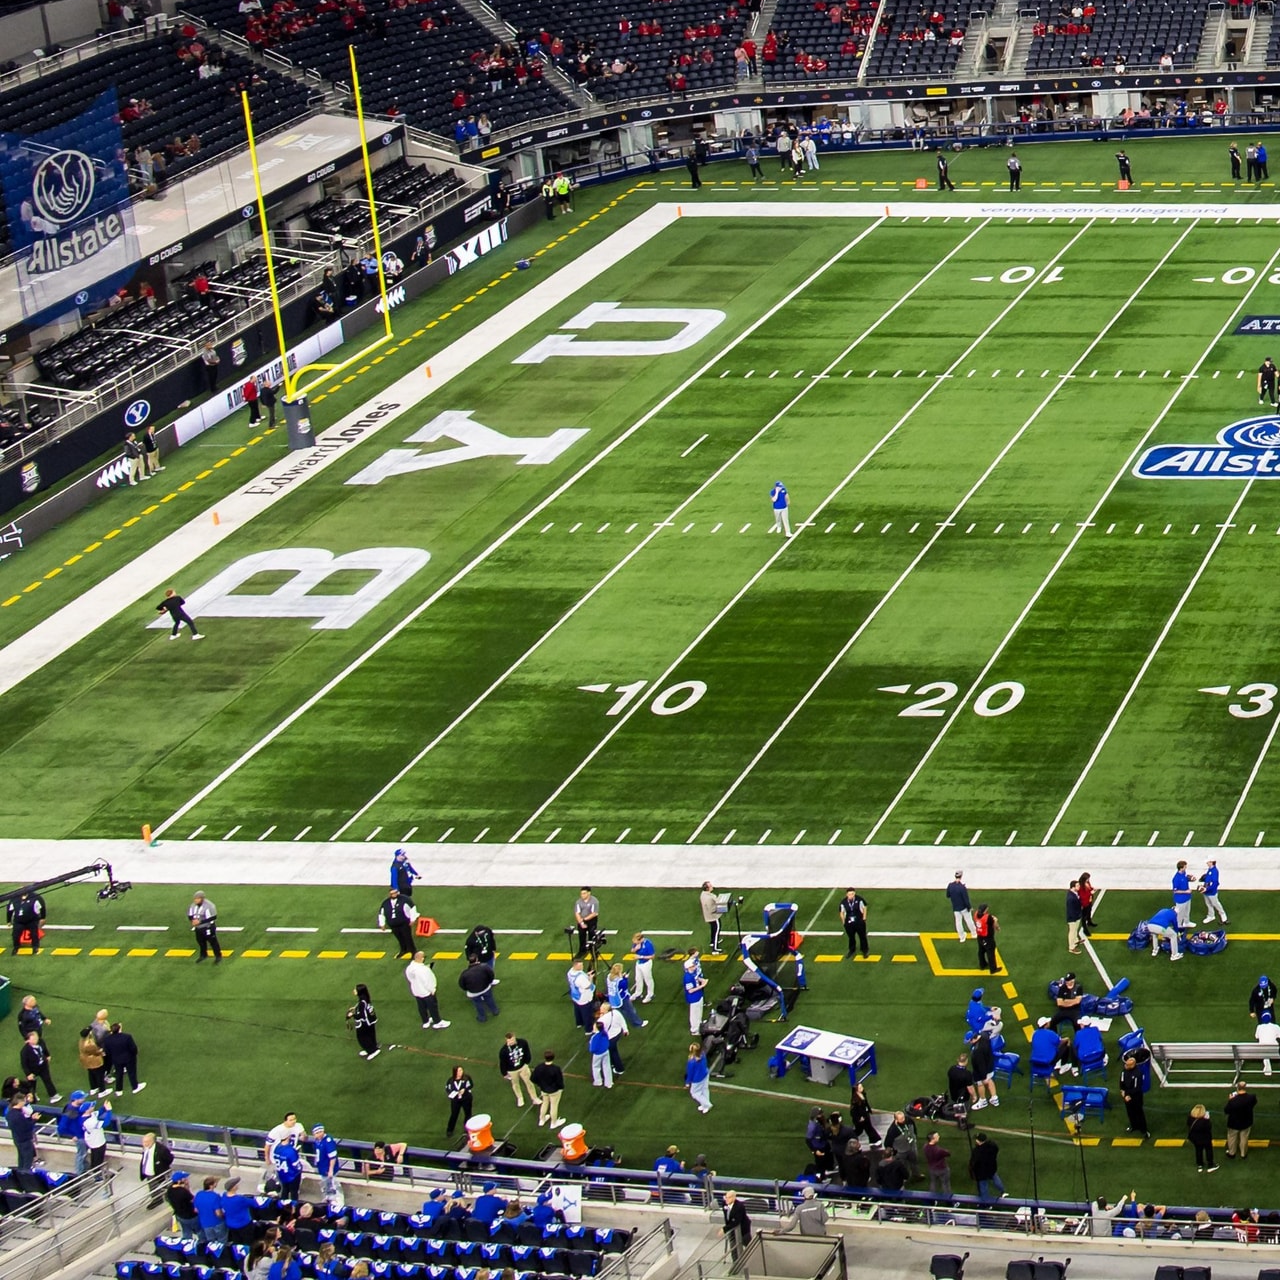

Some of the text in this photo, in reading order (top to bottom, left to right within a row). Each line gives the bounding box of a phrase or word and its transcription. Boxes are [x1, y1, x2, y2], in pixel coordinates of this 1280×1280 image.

[465, 196, 491, 223] ESPN
[28, 213, 122, 272] Allstate
[271, 353, 298, 384] LEAUE
[604, 680, 708, 716] 10
[897, 681, 1026, 718] 20
[419, 920, 430, 934] 10
